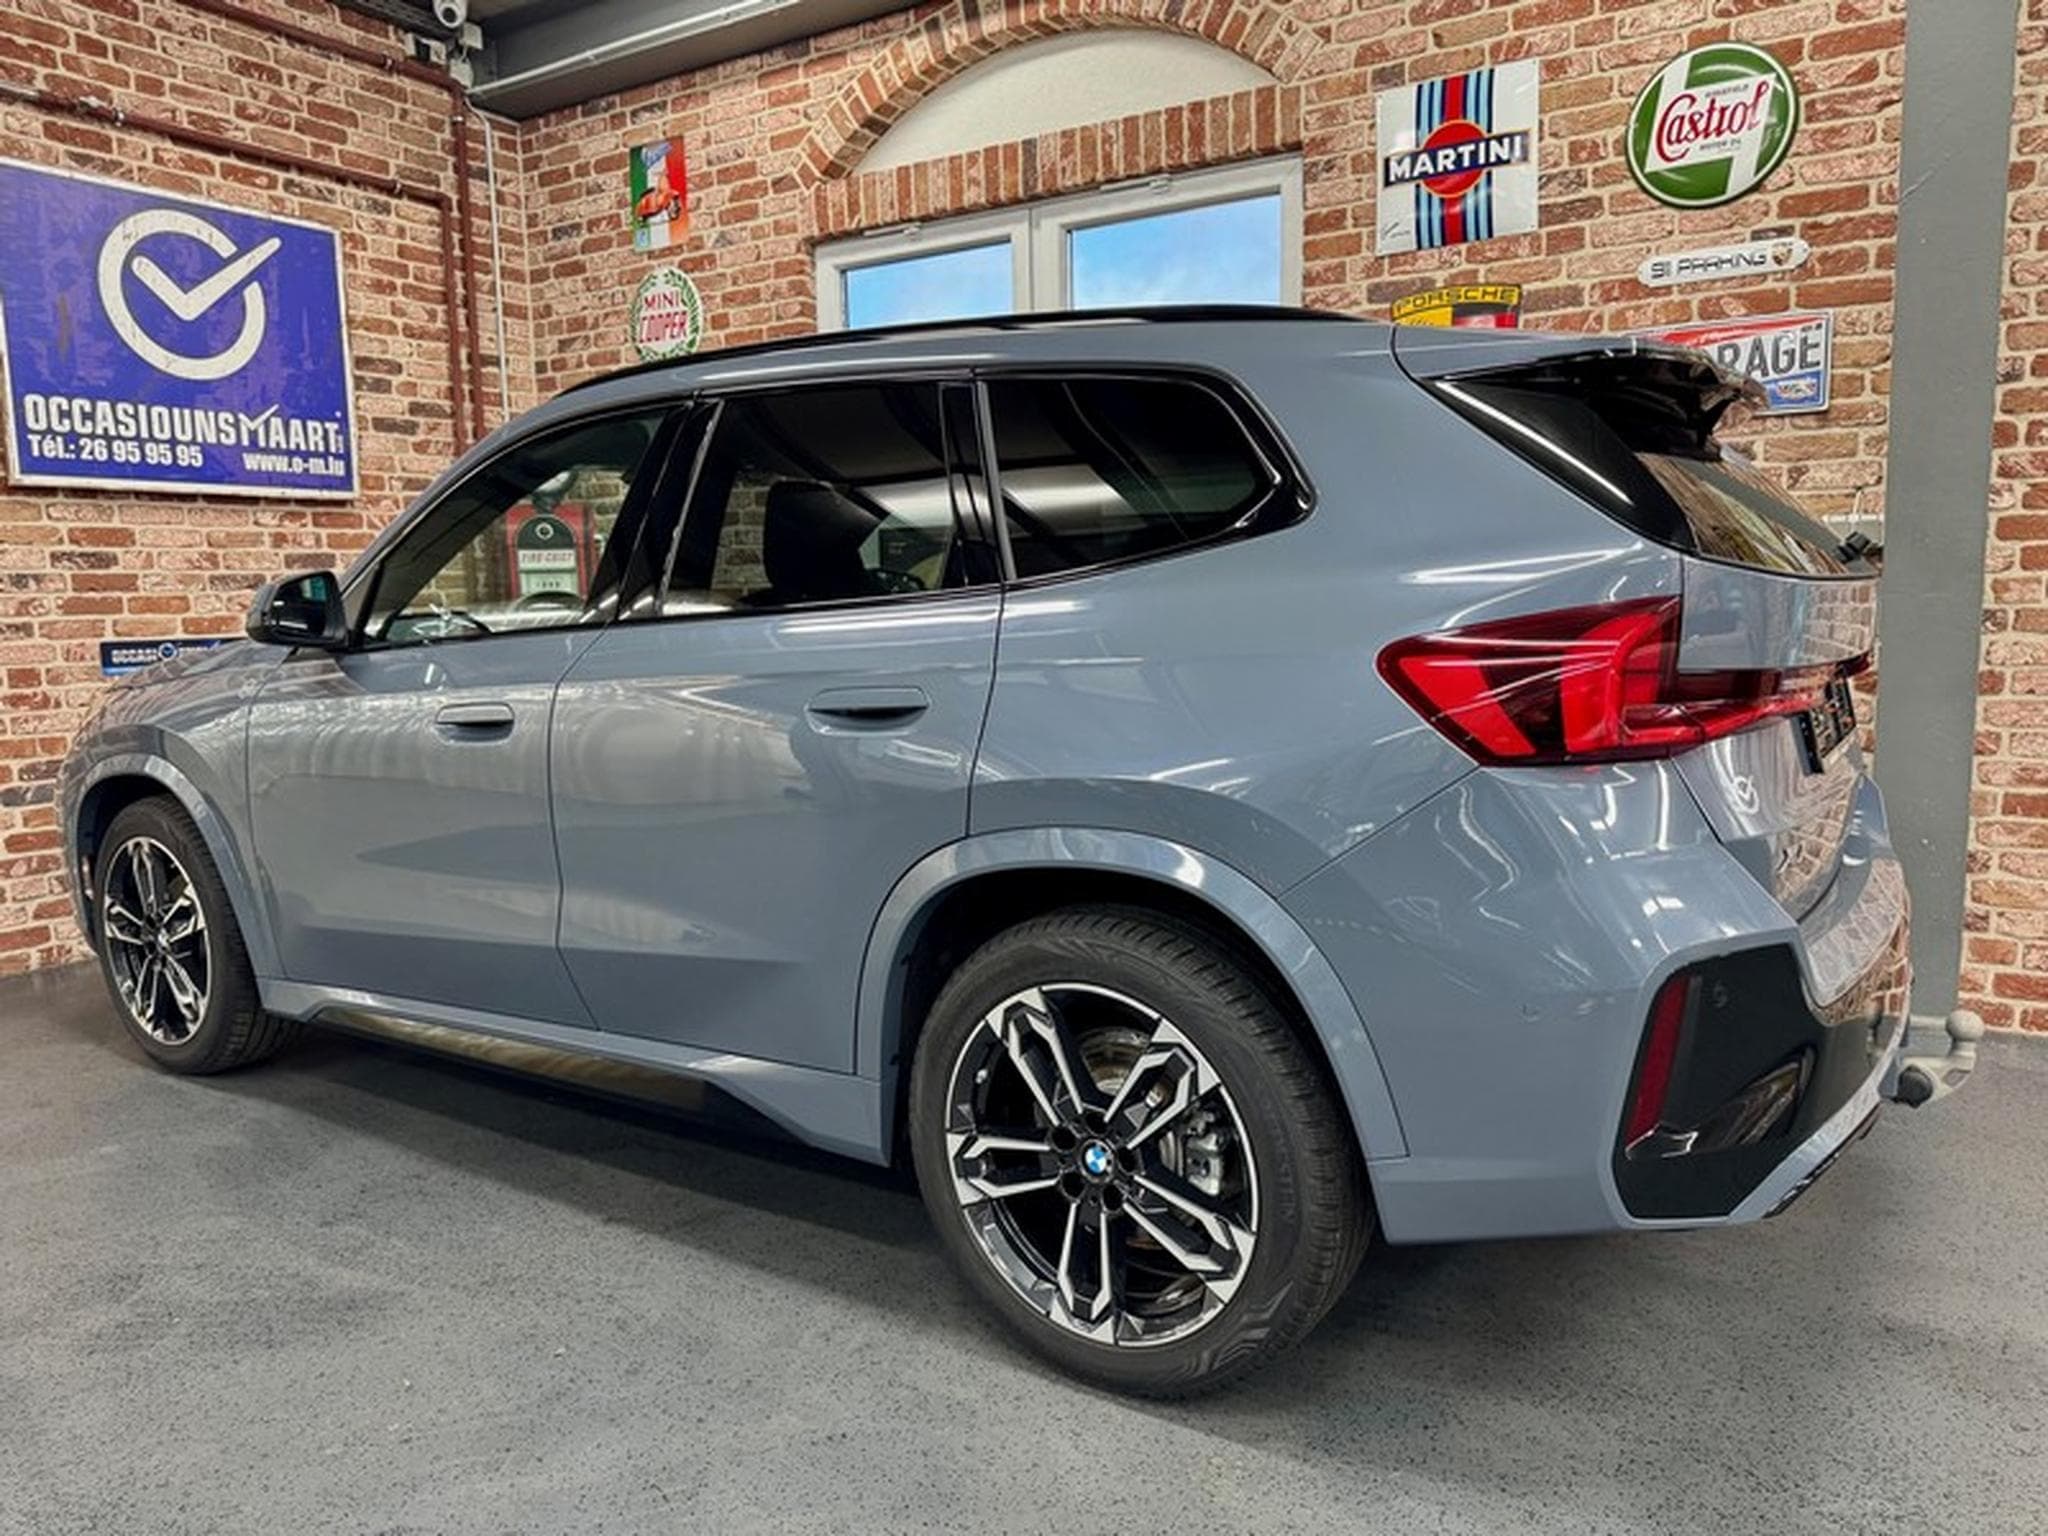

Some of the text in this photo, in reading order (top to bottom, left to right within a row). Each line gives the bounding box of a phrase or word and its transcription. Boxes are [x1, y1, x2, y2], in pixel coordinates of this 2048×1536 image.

[1656, 80, 1770, 164] Castrol
[1388, 134, 1522, 183] MARTINI
[1676, 253, 1767, 275] PARKING
[644, 290, 680, 310] MINI
[1394, 286, 1517, 314] PORSCHE
[640, 311, 688, 342] COOPER
[1716, 332, 1822, 378] RAGE
[79, 437, 108, 462] 26
[112, 439, 141, 464] 95
[144, 441, 173, 466] 95
[176, 443, 203, 468] 95
